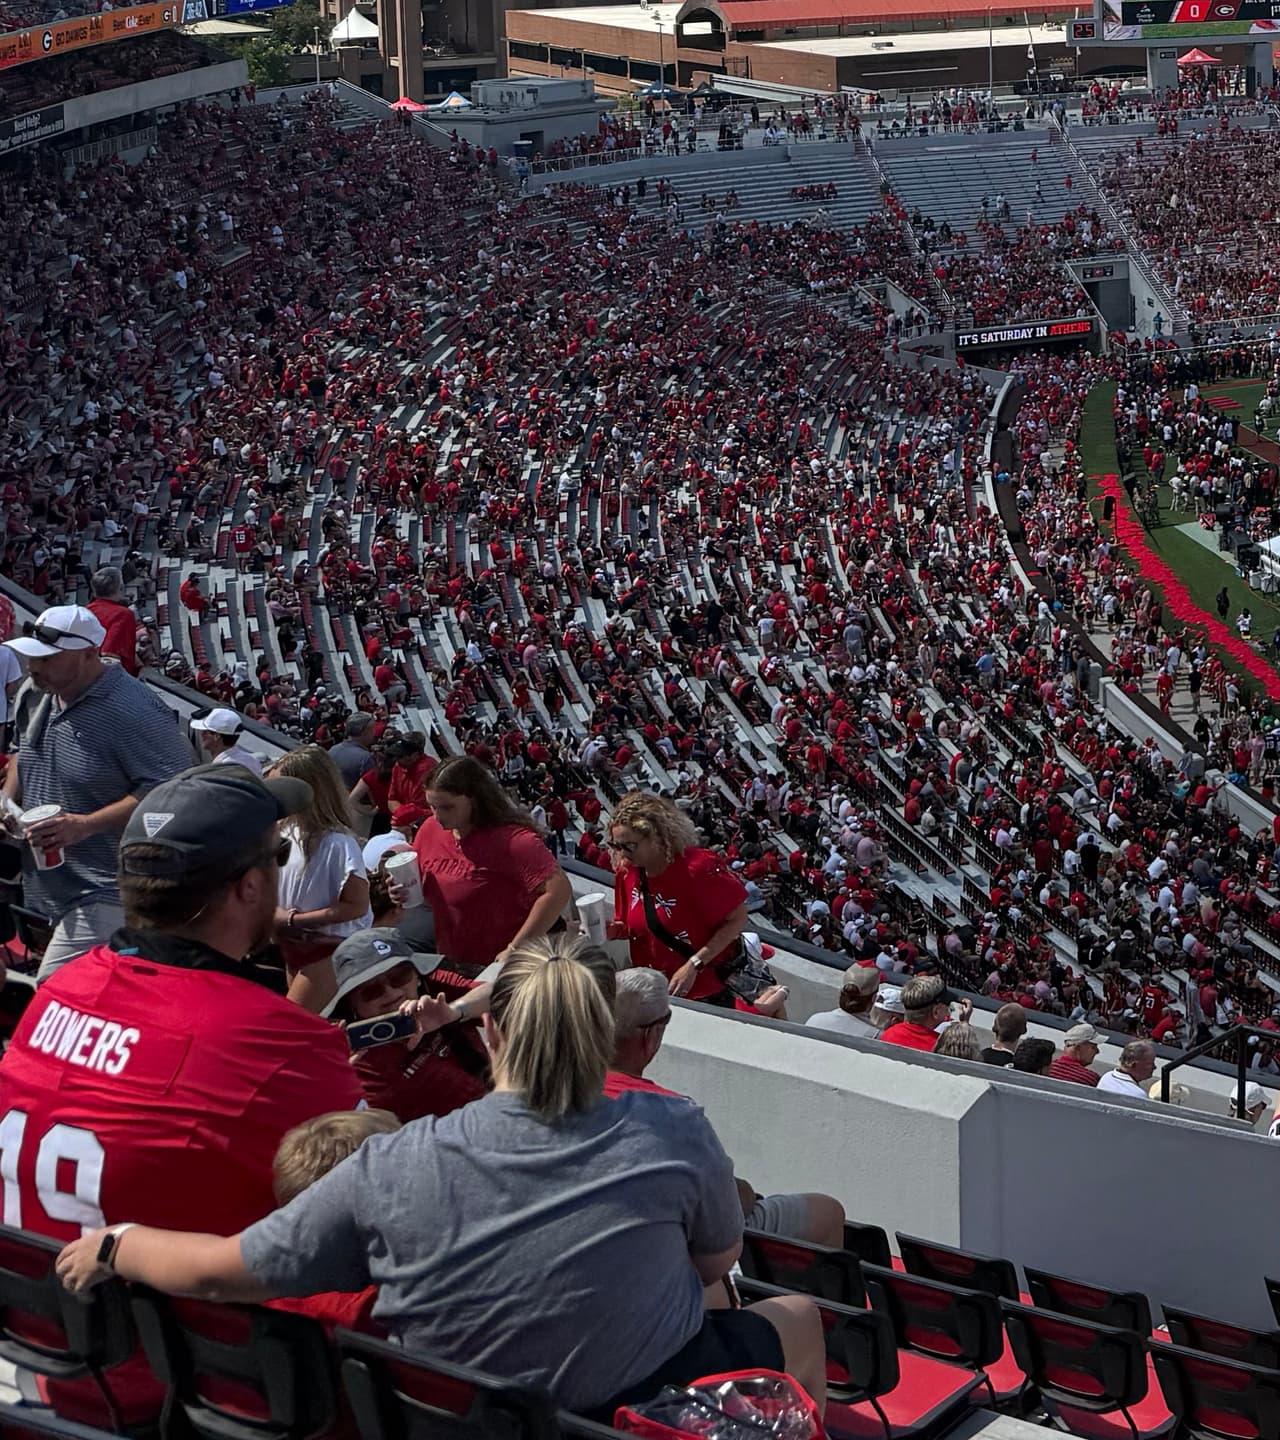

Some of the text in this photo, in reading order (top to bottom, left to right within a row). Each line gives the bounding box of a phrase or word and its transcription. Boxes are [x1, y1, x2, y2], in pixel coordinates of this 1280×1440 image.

[1190, 4, 1200, 18] 0
[1074, 24, 1094, 37] 25
[14, 117, 27, 133] Need
[959, 322, 1091, 346] IT'S SATURDAY IN ATHENS
[28, 1000, 140, 1076] BOWERS
[0, 1108, 106, 1238] 19
